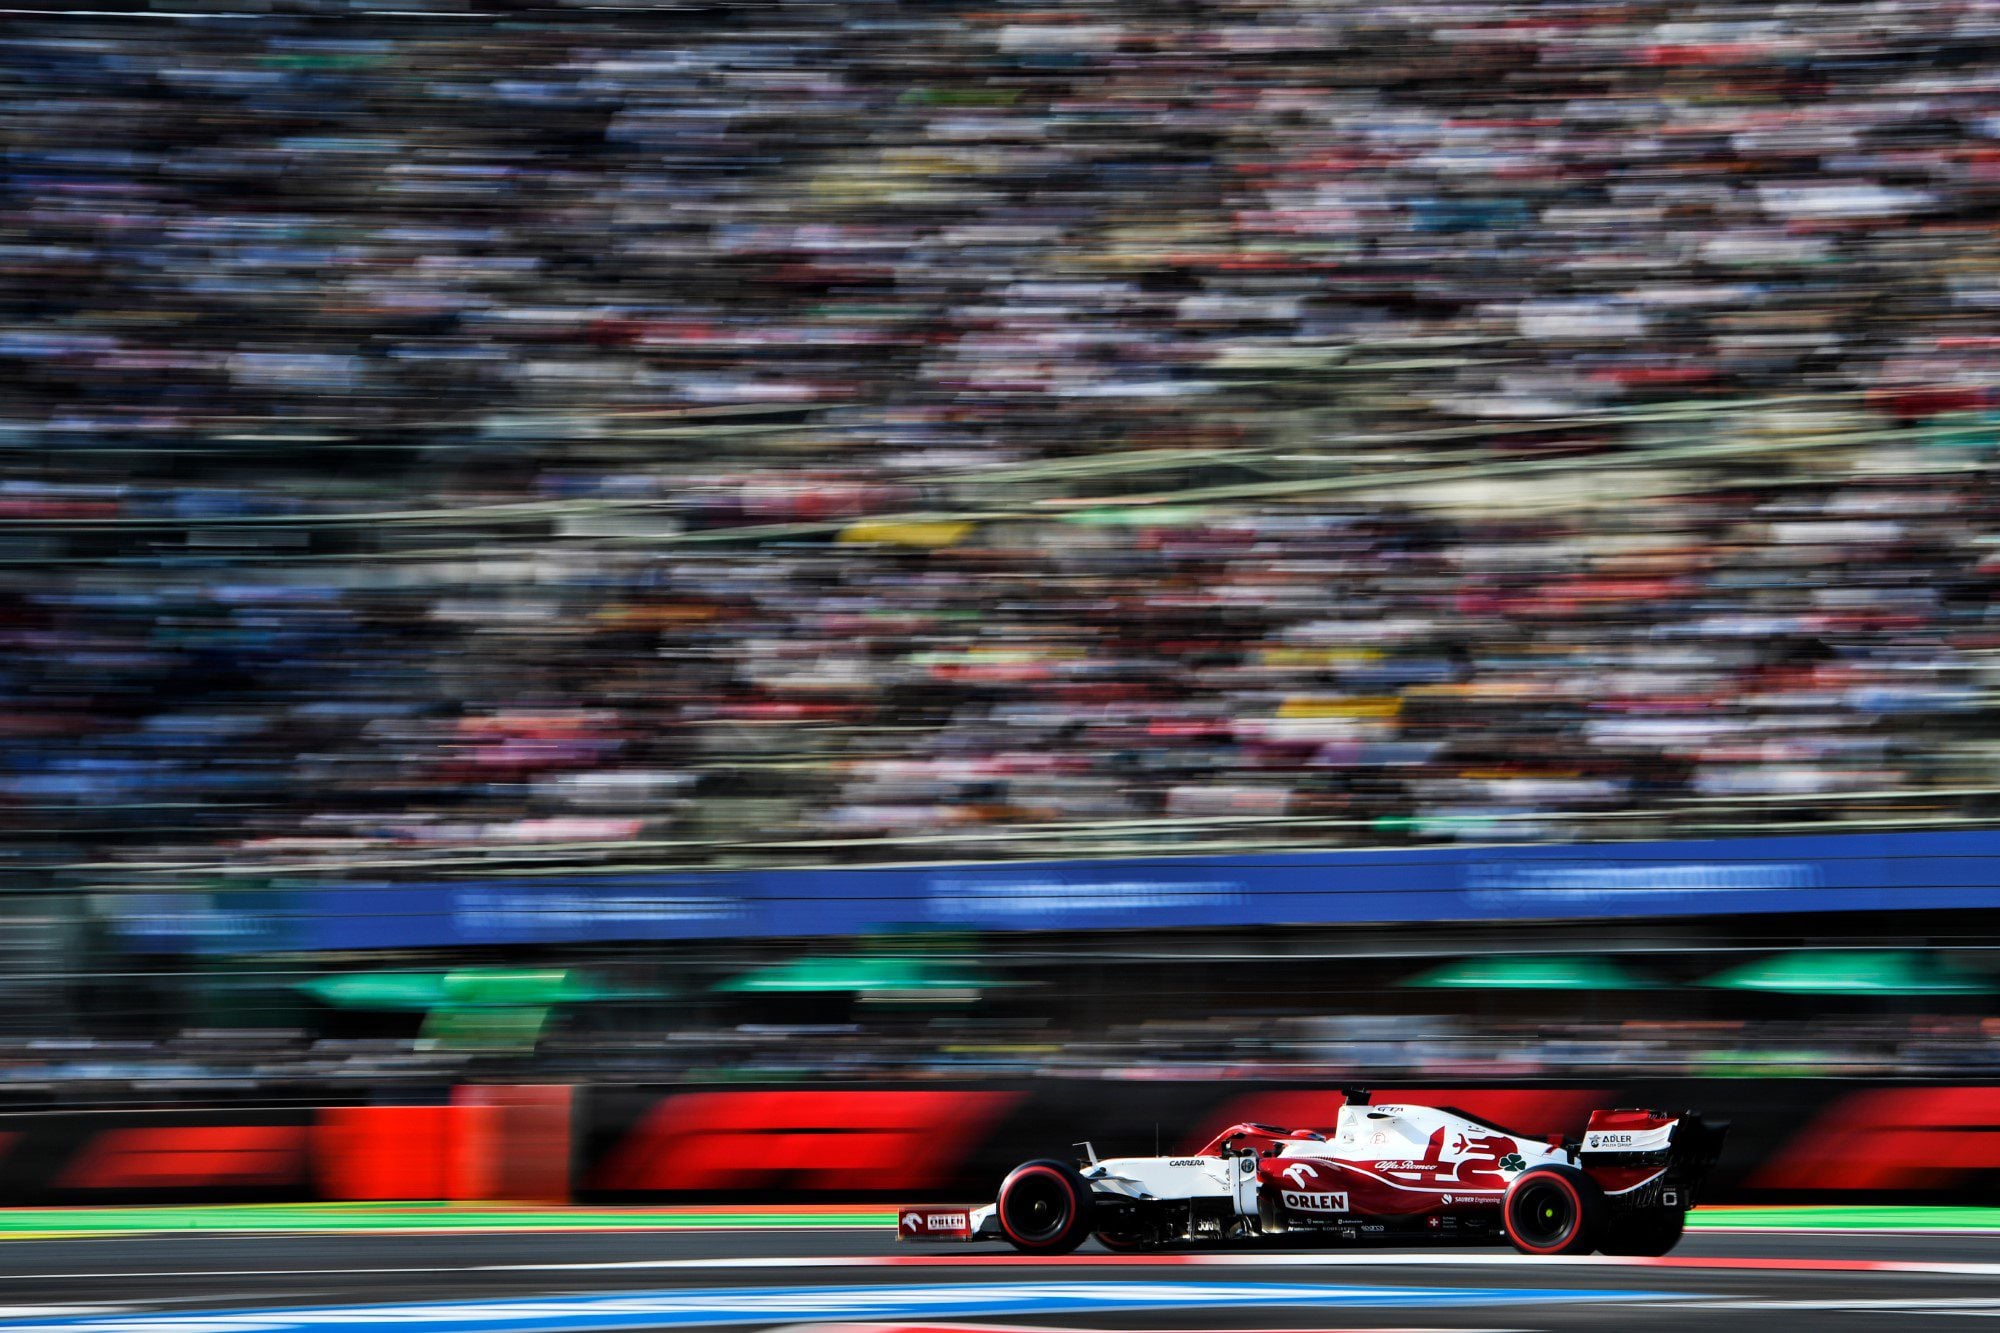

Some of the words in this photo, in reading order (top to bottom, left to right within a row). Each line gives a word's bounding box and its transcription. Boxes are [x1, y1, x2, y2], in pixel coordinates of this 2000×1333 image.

[1602, 1135, 1632, 1143] ADLER
[1169, 1159, 1205, 1167] CARRERA
[1374, 1160, 1399, 1171] Alfa
[1400, 1160, 1438, 1171] Romeo
[1286, 1194, 1344, 1209] ORLEN
[1475, 1196, 1501, 1204] Engineering
[930, 1215, 963, 1228] ORLEN
